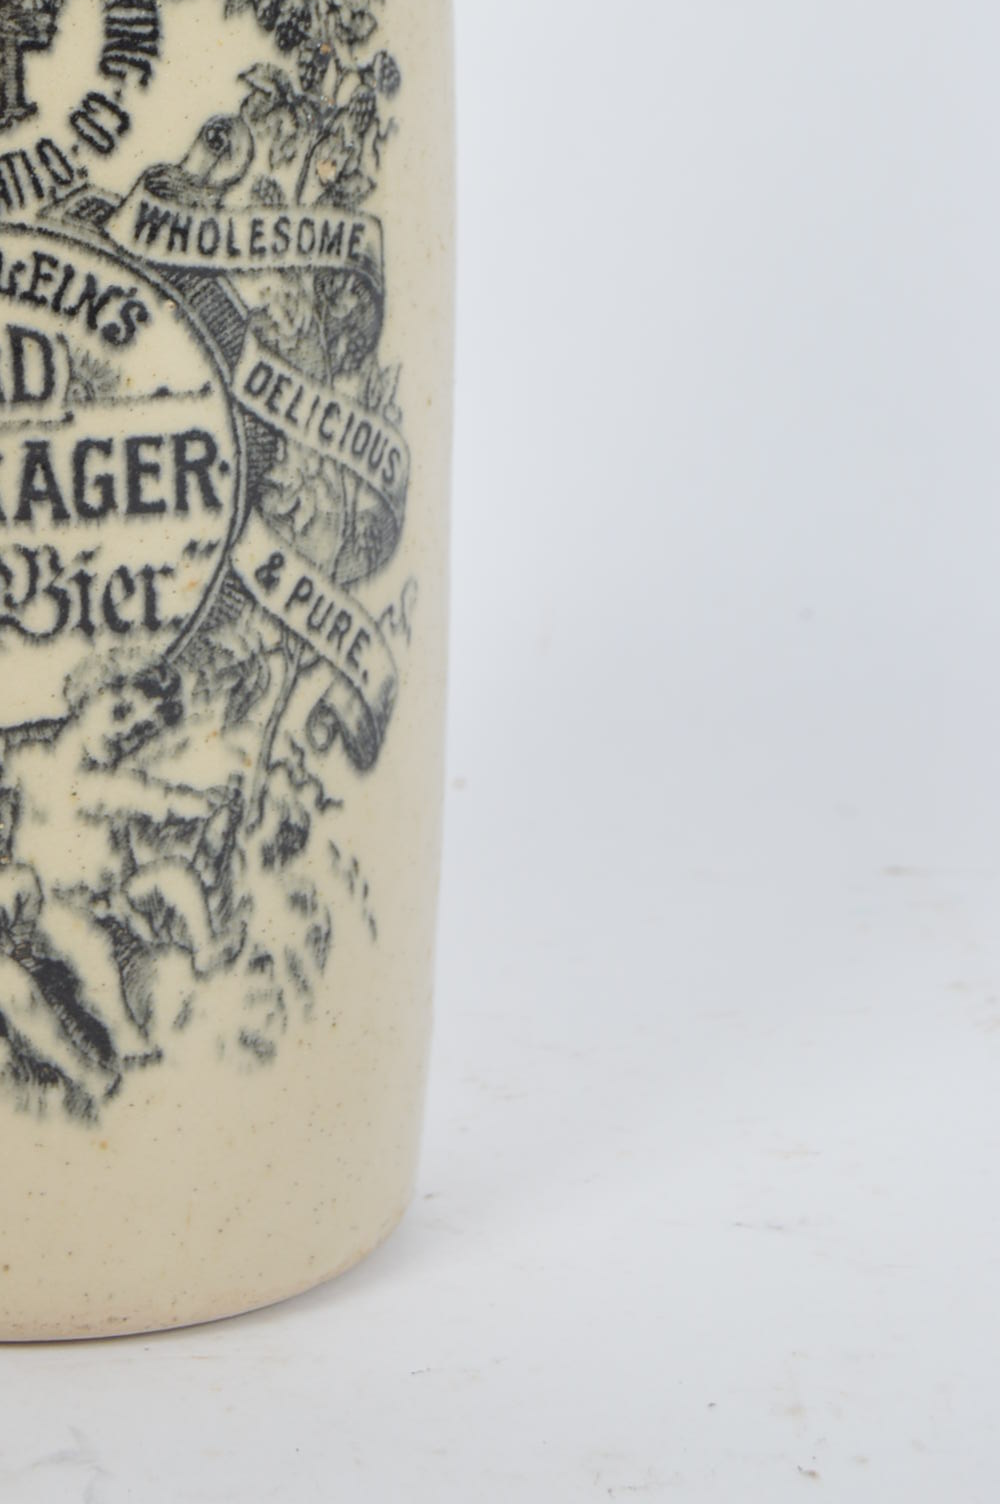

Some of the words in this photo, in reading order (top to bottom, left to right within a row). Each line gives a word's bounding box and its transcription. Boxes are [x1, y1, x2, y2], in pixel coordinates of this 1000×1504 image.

[134, 200, 368, 260] WHOLESOME
[244, 360, 402, 486] DELICIOUS
[254, 551, 288, 594] &
